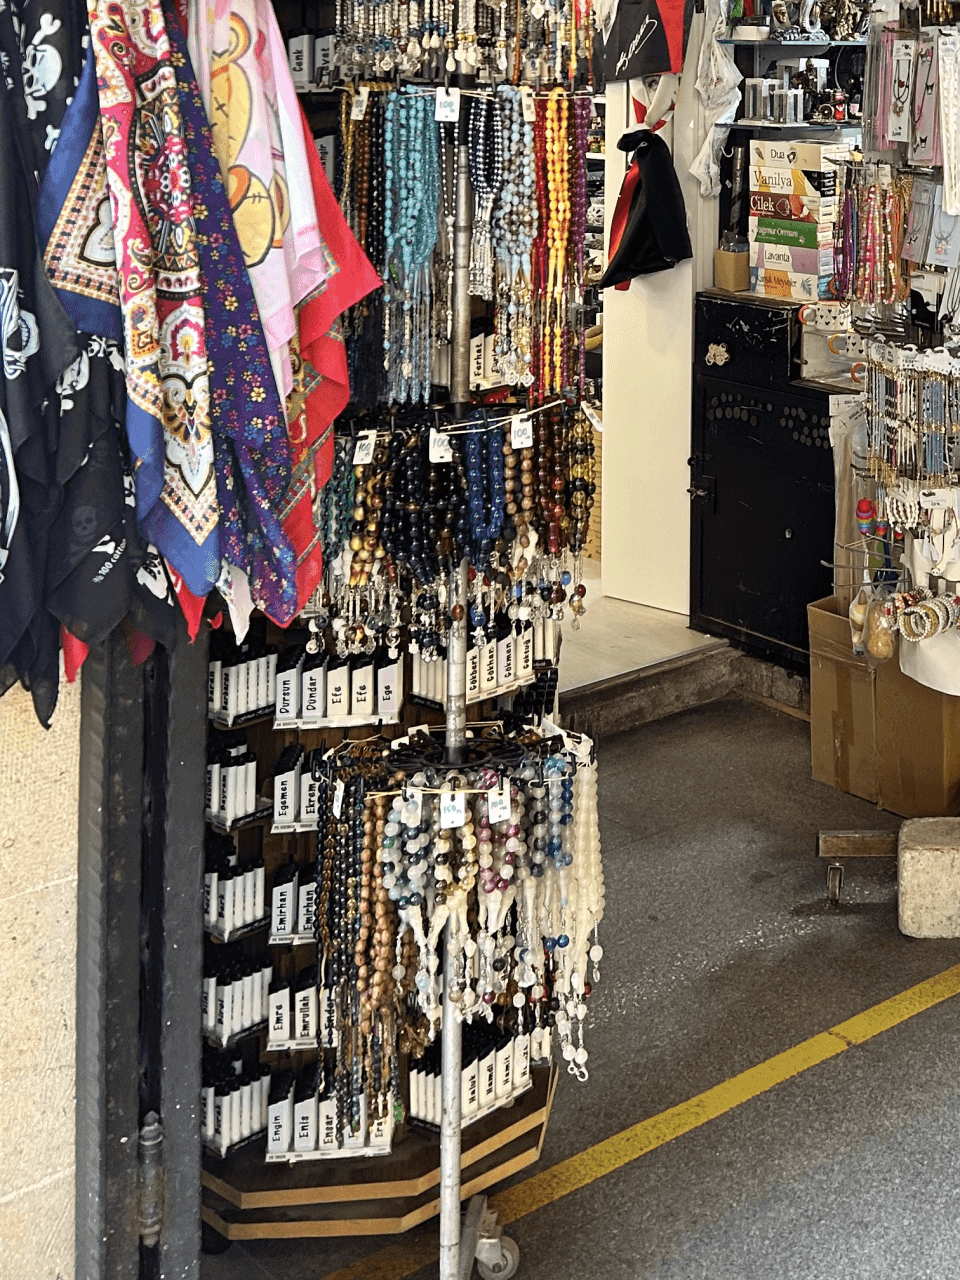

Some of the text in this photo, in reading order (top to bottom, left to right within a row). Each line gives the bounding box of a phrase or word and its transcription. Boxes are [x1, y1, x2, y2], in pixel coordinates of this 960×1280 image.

[292, 48, 304, 73] Cenk
[770, 148, 785, 160] Dua
[753, 170, 793, 189] Vanilya
[750, 194, 775, 212] Çilek
[764, 249, 790, 263] Lavanta
[474, 342, 483, 377] Ferhat
[357, 441, 371, 453] 100
[432, 437, 450, 448] 100
[513, 427, 528, 440] 100
[110, 538, 127, 563] cotton
[279, 679, 291, 714] Dursun
[306, 676, 318, 712] Dündar
[331, 685, 342, 705] Efe
[356, 684, 367, 703] Efe
[382, 684, 391, 702] Ege
[278, 780, 288, 817] Egemen
[306, 783, 317, 815] Ekrem
[276, 890, 288, 932] Emirhan
[303, 889, 315, 932] Emirhan
[273, 1004, 284, 1032] Emre
[299, 995, 310, 1038] Emrullah
[486, 1063, 494, 1096] Hamdi
[503, 1054, 511, 1086] Hamit
[468, 1073, 477, 1105] Haluk
[272, 1114, 281, 1142] Engin
[299, 1115, 310, 1139] Enis
[323, 1113, 334, 1146] Ensar
